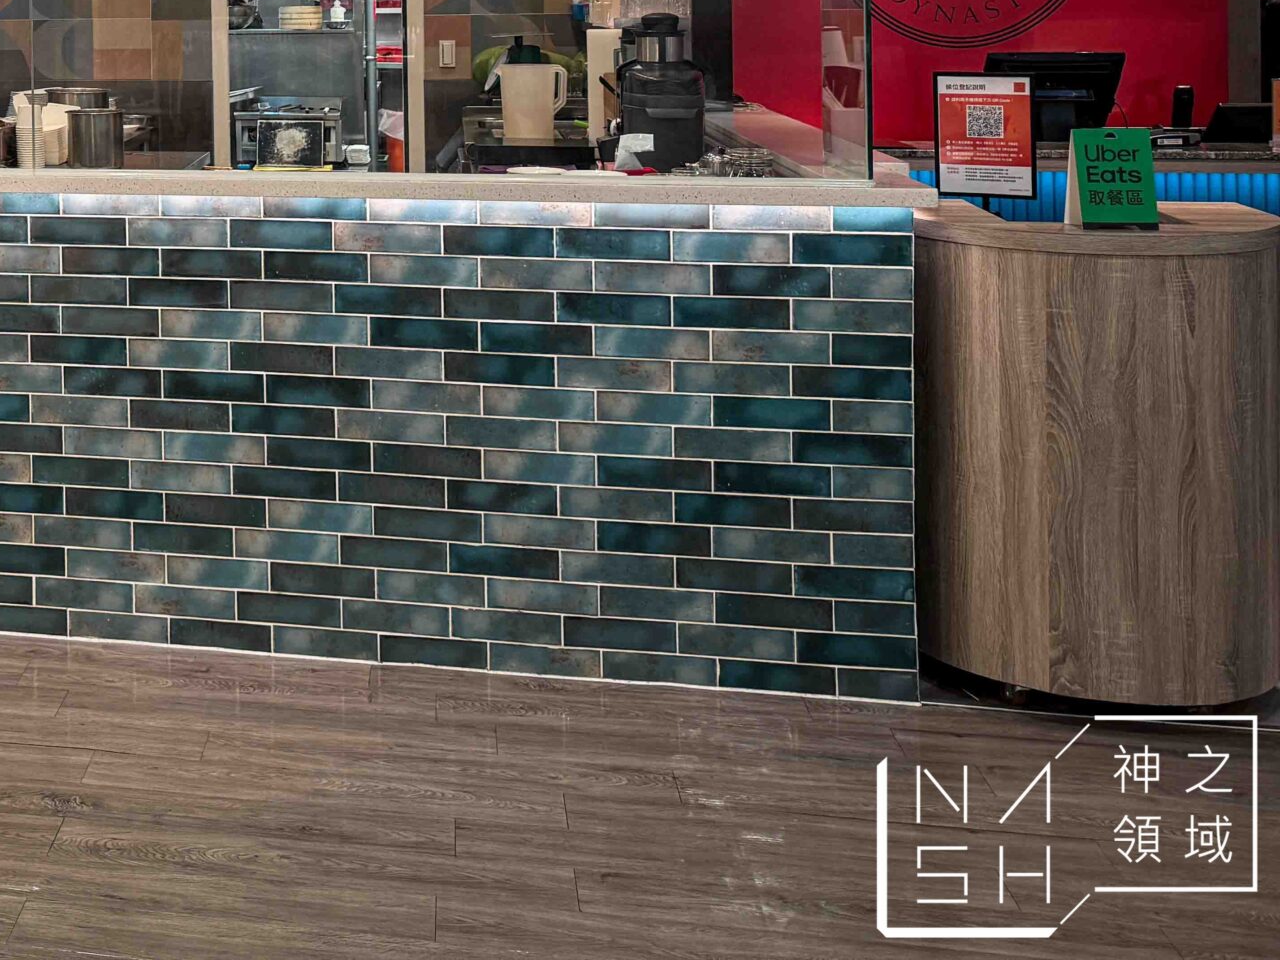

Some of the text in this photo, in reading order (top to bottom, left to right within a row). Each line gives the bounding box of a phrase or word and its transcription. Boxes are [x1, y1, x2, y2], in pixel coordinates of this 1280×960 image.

[1084, 144, 1140, 163] Uber
[1086, 165, 1143, 184] Eats
[1088, 189, 1145, 206] 取餐區
